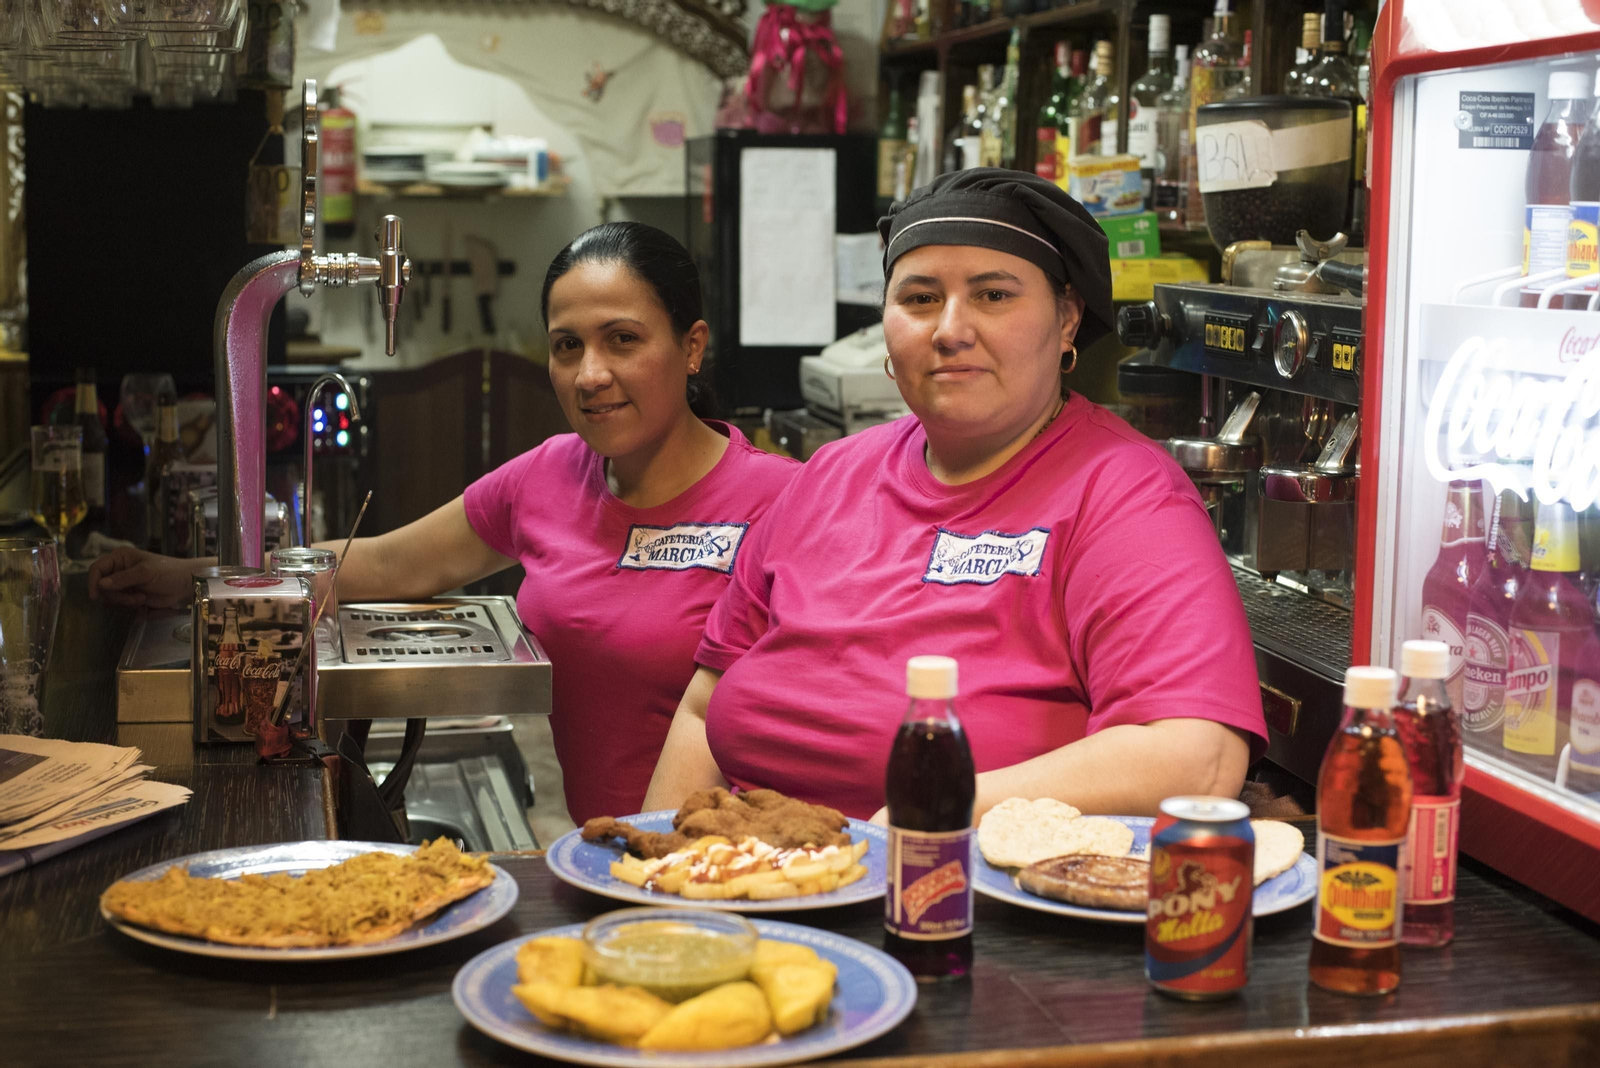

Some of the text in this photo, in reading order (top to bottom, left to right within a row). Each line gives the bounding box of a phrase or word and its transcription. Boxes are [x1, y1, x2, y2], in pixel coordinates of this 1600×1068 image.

[1461, 94, 1491, 103] Coca-Cola
[1493, 125, 1529, 135] CC0172529
[654, 534, 705, 547] CAFETERIA
[647, 547, 705, 563] MARCIA
[960, 544, 1023, 560] CAFETERIA
[950, 558, 1009, 576] MARCIA
[242, 663, 281, 679] Coca-Cola
[1148, 875, 1242, 919] PONY
[1156, 909, 1225, 943] Malta
